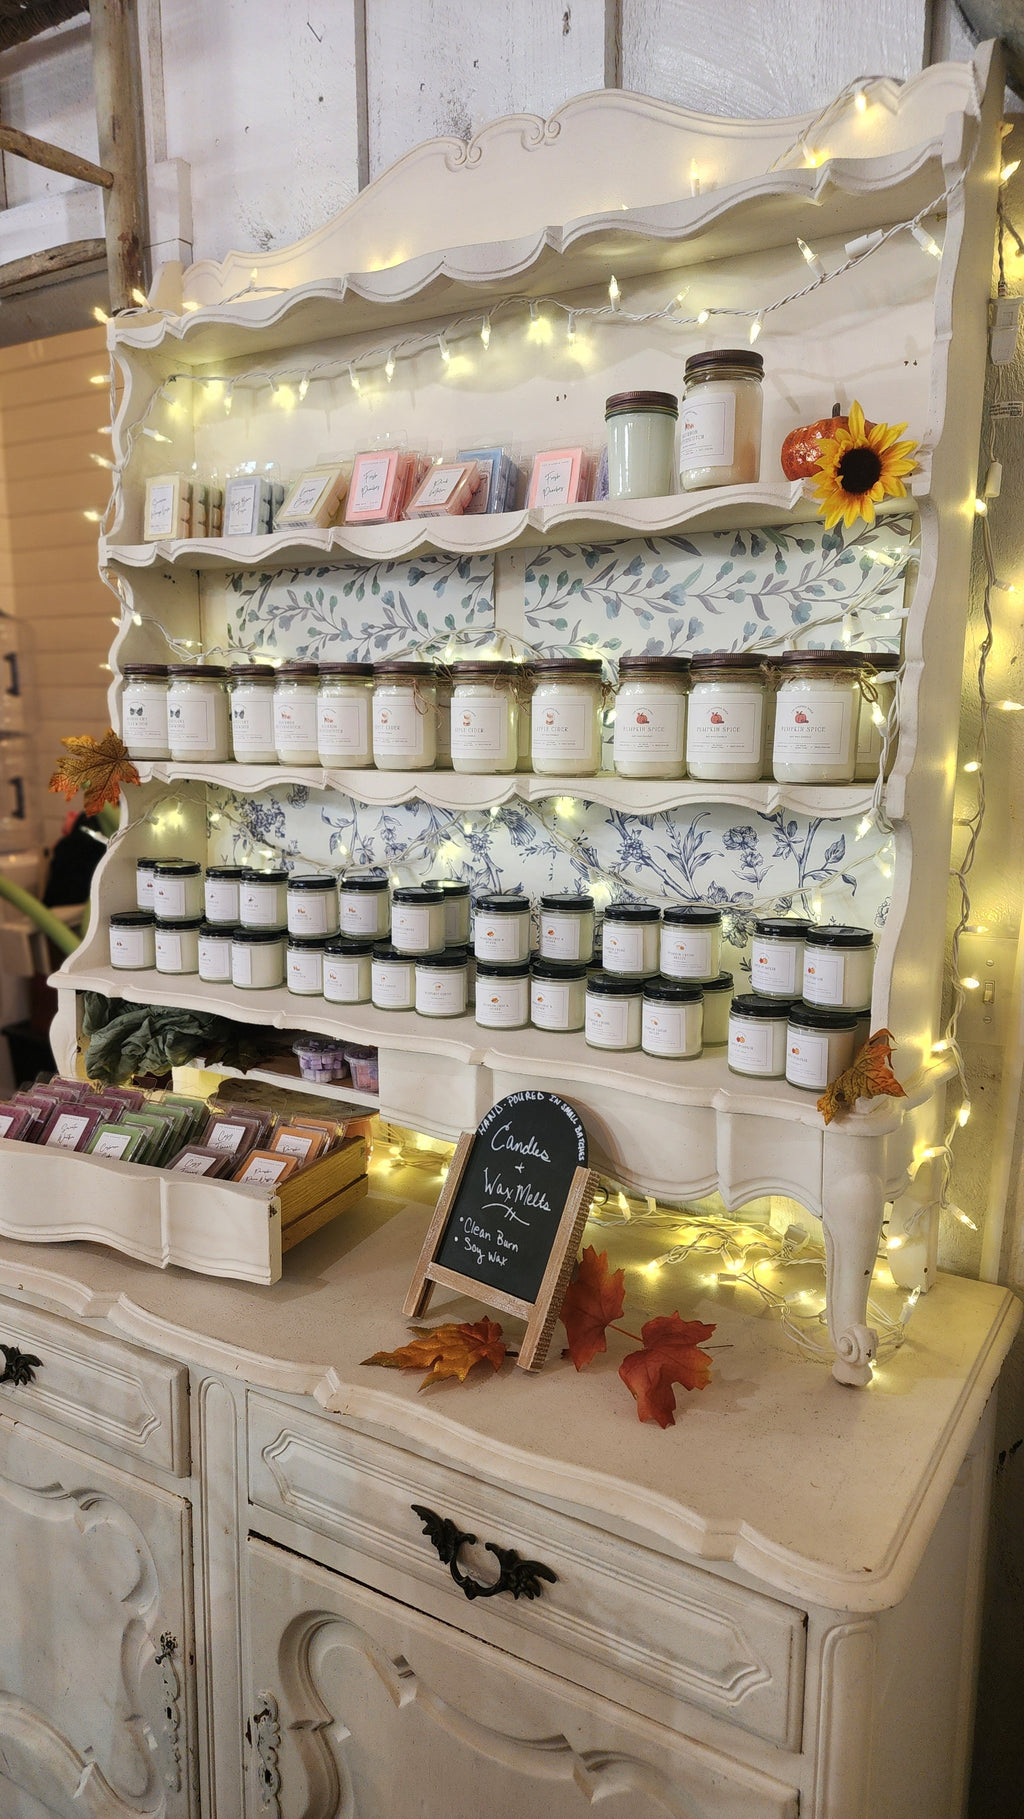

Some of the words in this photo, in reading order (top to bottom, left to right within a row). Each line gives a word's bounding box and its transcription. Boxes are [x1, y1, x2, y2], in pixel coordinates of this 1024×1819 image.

[490, 1120, 552, 1163] Candles
[548, 1094, 562, 1106] IN
[560, 1103, 579, 1125] SMALL
[574, 1124, 585, 1162] BATCHES
[483, 1167, 514, 1202] Wax
[514, 1183, 551, 1211] Melts
[464, 1217, 491, 1241] Clean
[496, 1229, 519, 1252] Burn
[464, 1236, 486, 1265] Soy
[487, 1251, 508, 1267] Wax
